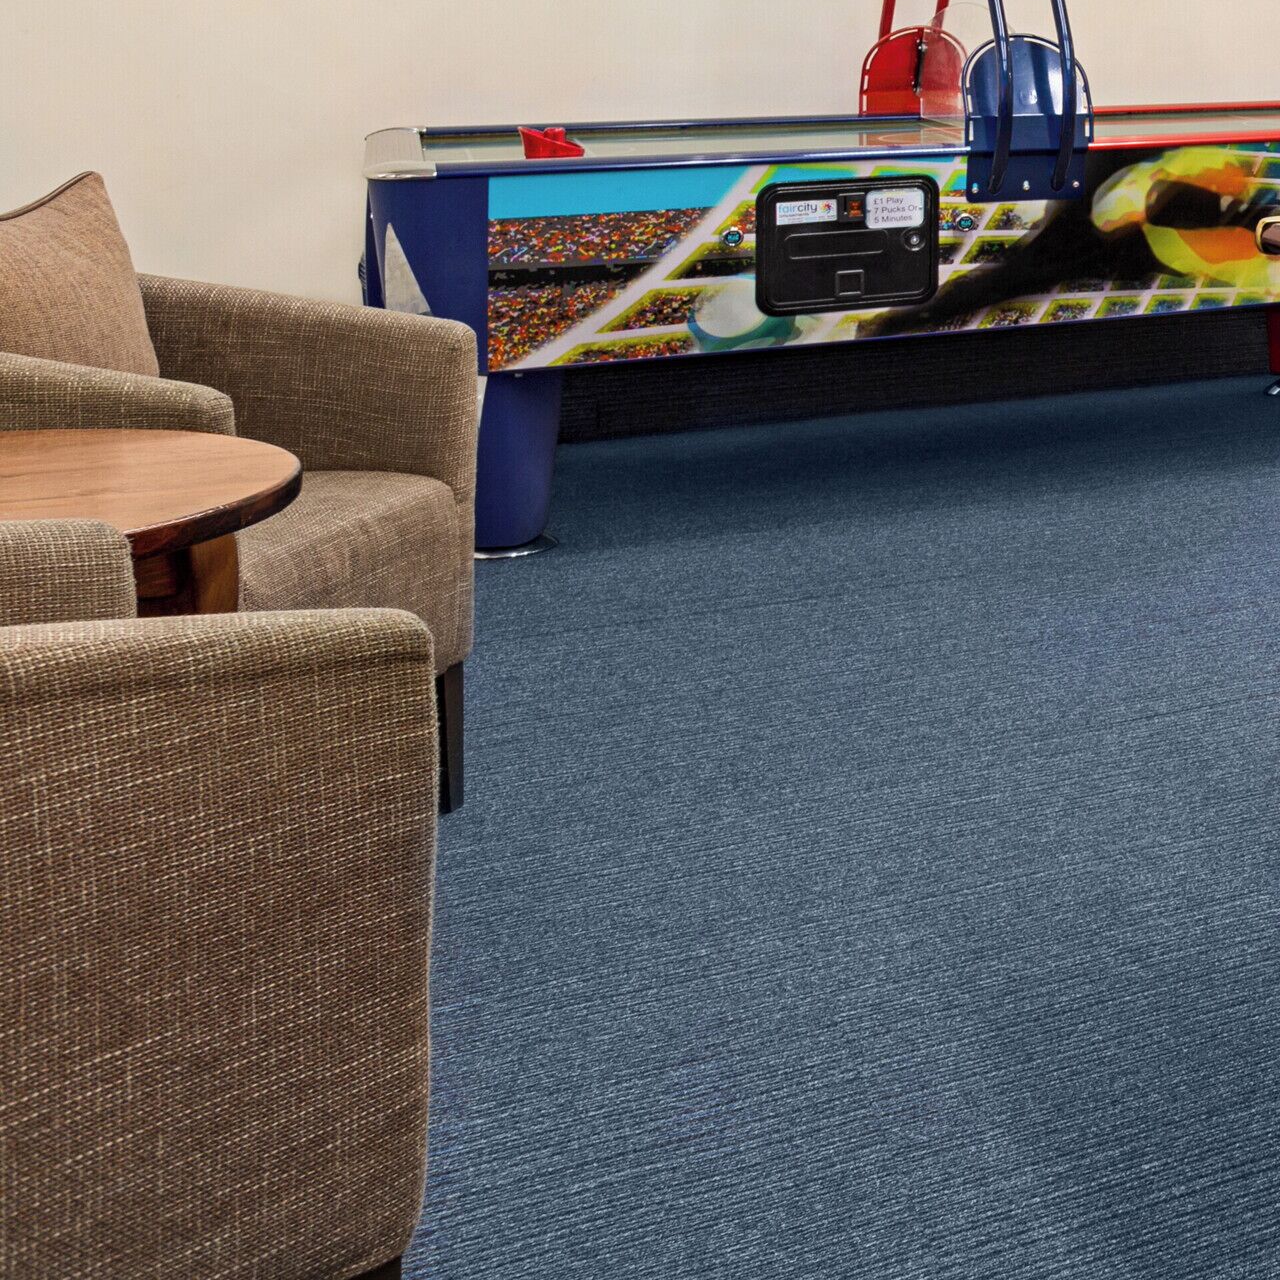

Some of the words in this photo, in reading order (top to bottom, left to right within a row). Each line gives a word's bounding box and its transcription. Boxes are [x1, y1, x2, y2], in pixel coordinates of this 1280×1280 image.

[886, 197, 904, 205] Play
[881, 205, 906, 213] Pucks
[908, 204, 919, 212] Or
[874, 216, 880, 224] 5
[881, 215, 913, 223] Minutes
